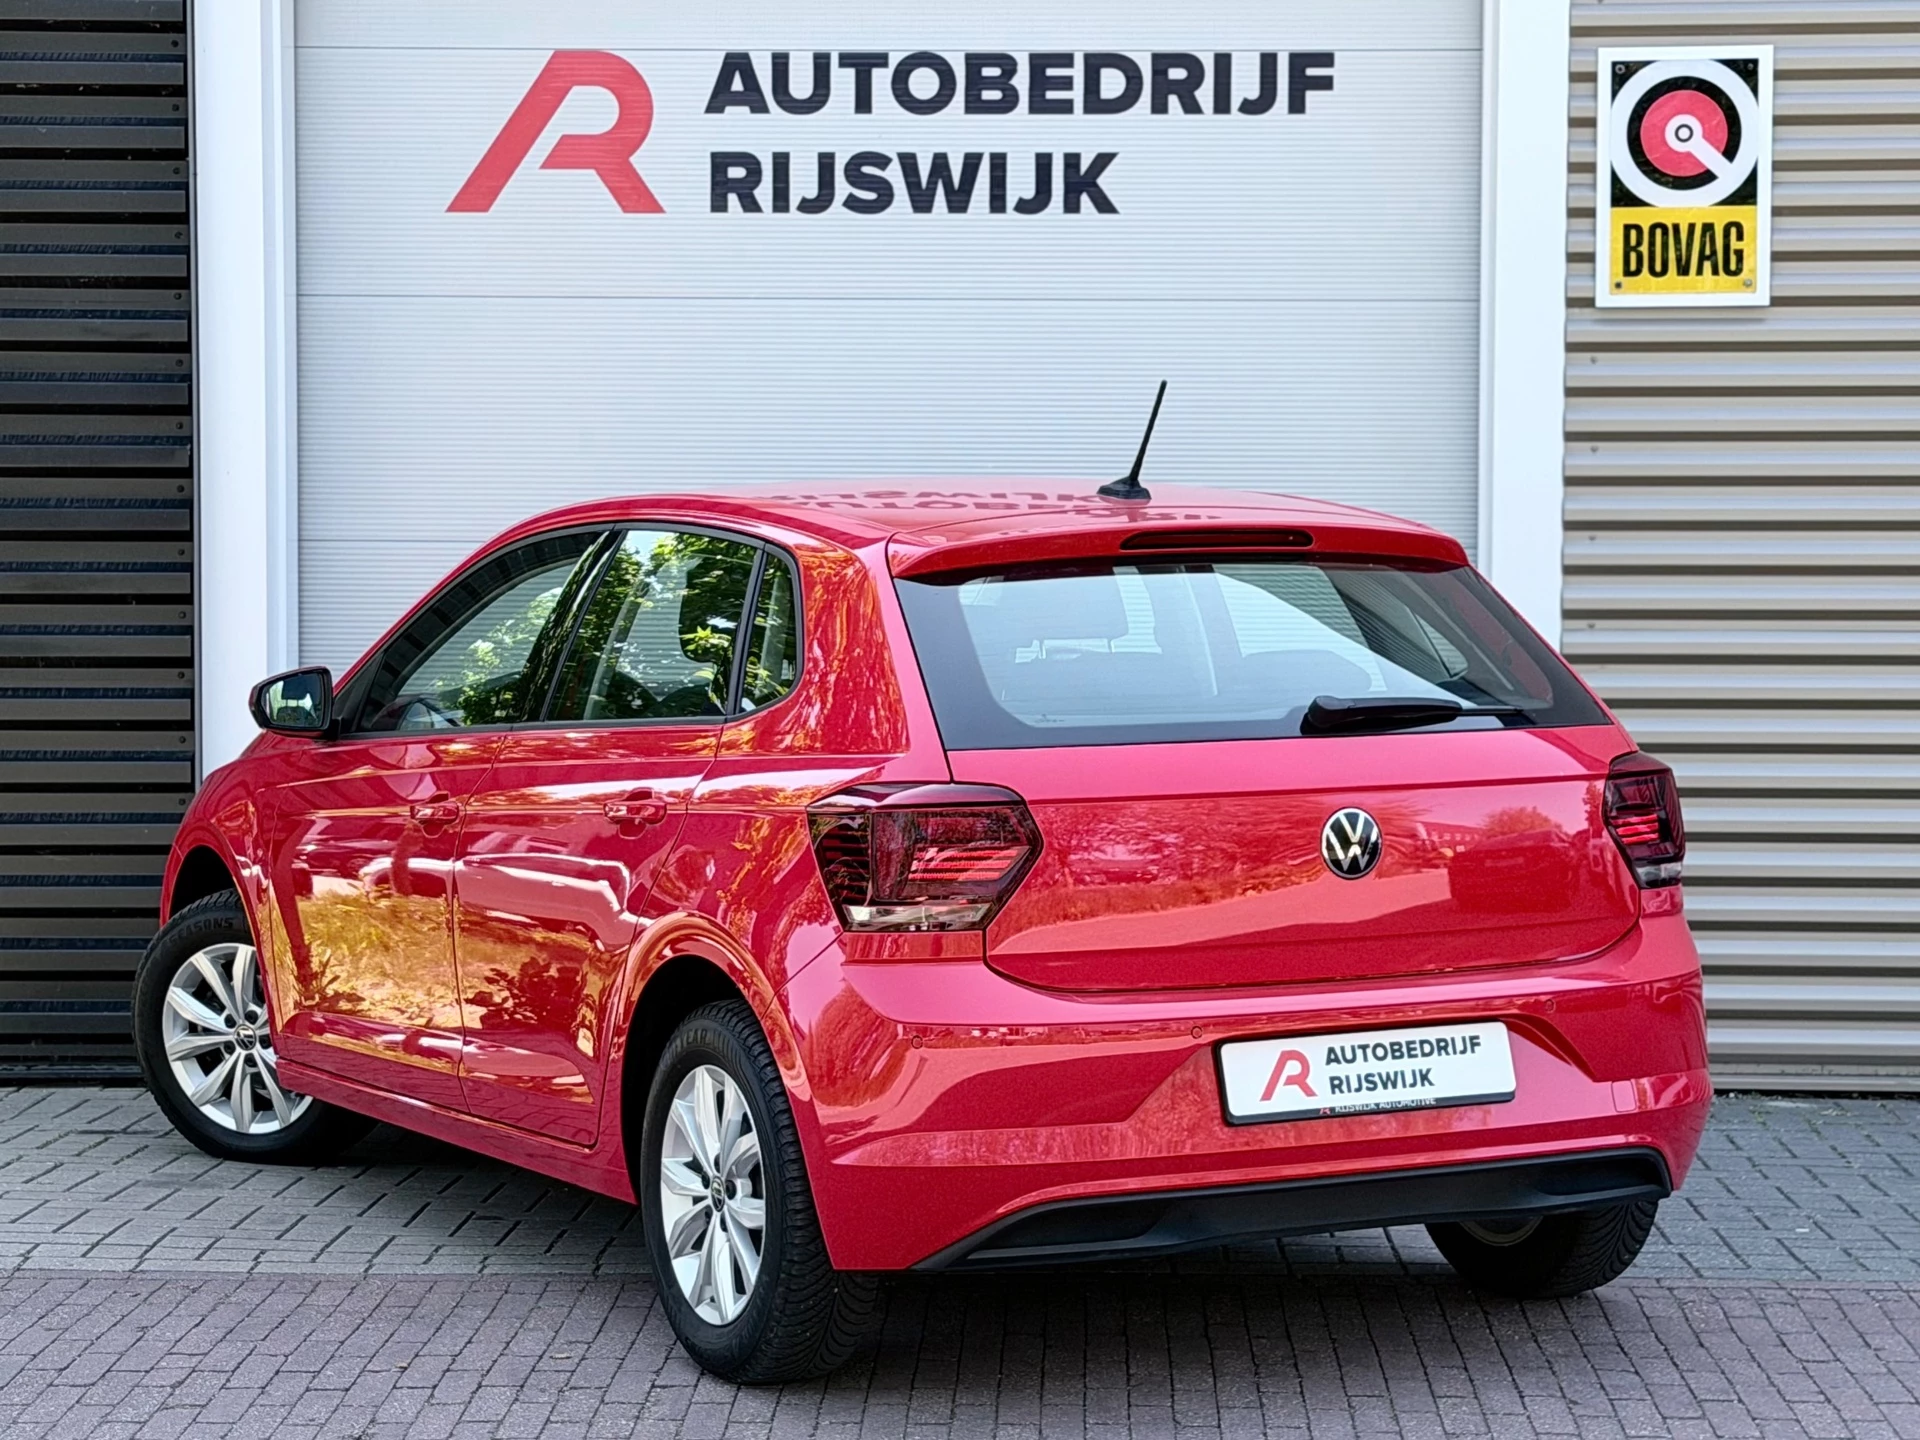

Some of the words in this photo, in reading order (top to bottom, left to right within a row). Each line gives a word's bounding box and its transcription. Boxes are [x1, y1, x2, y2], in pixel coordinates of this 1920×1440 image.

[704, 51, 1335, 115] AUTOBEDRIJF
[710, 151, 1120, 215] RIJSWIJK
[1622, 221, 1745, 278] BOVAG
[1325, 1034, 1482, 1066] AUTOBEDRIJF
[1328, 1067, 1436, 1096] RIJSWIJK
